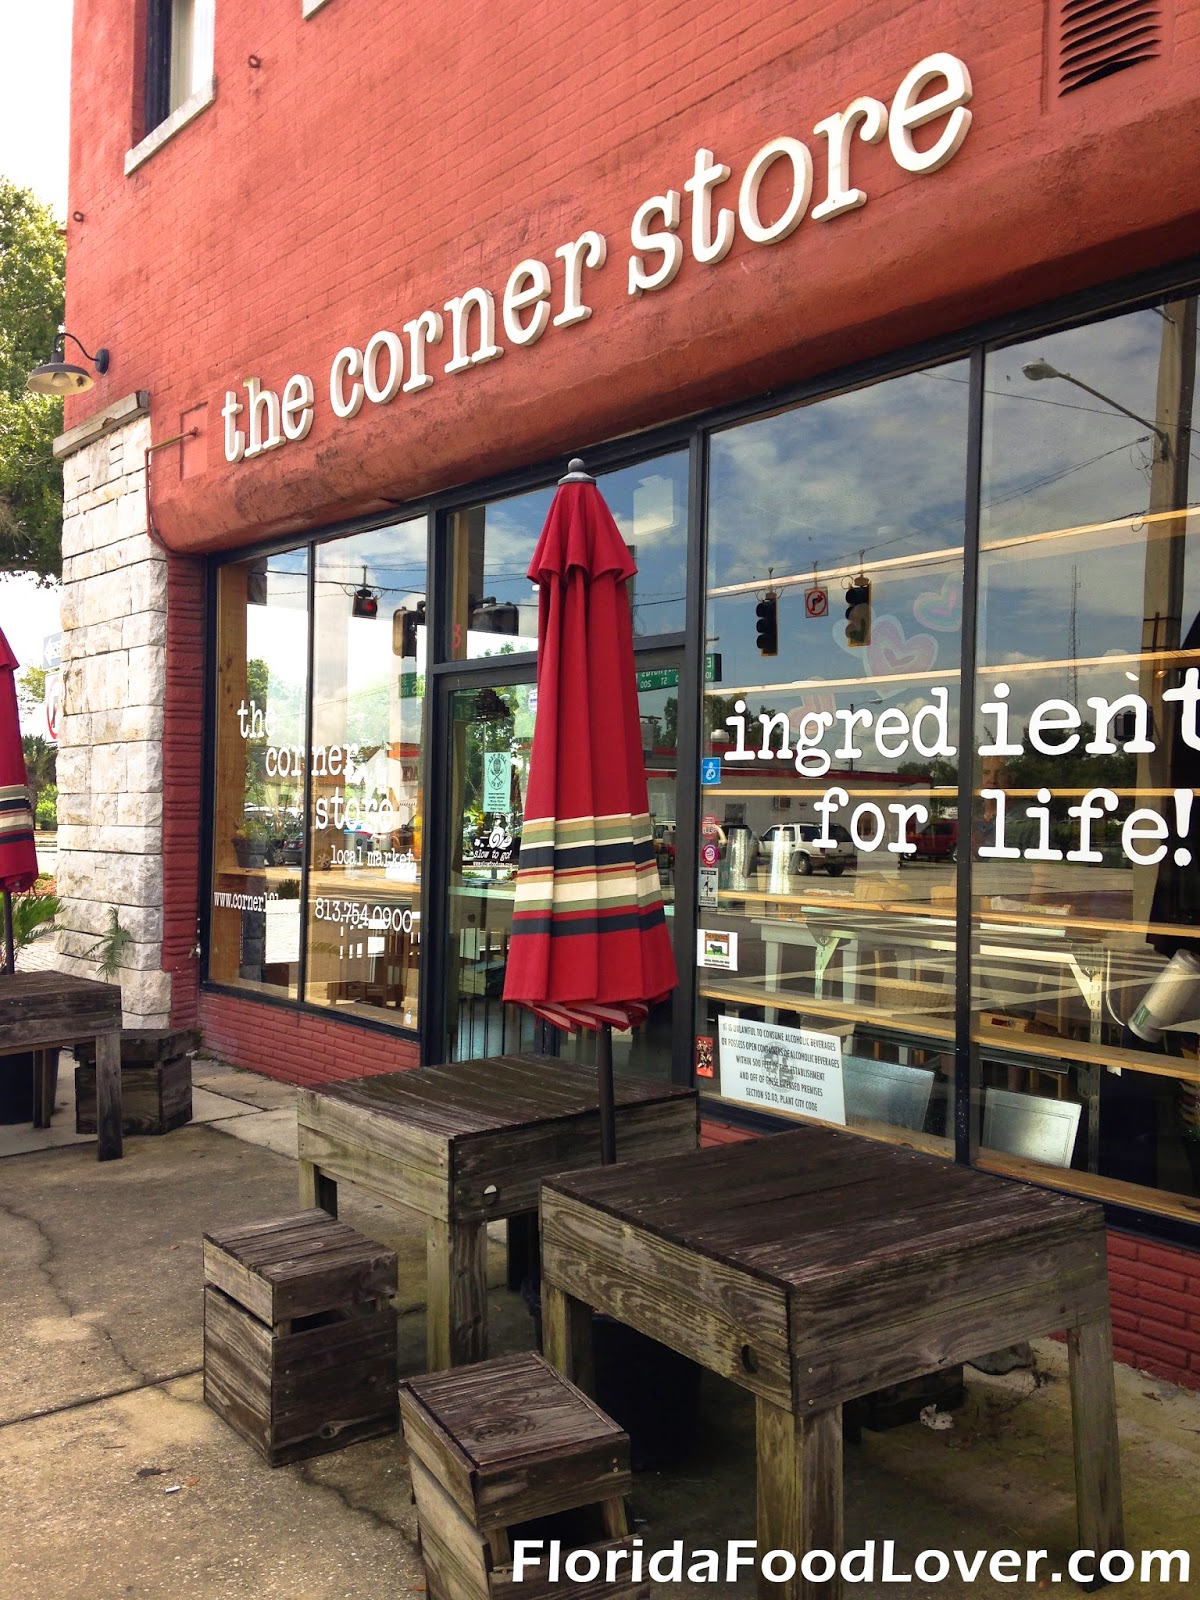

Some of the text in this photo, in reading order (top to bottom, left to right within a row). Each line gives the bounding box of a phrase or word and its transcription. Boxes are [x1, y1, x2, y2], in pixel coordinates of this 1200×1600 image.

[222, 52, 974, 463] the corner store
[315, 787, 394, 833] store
[812, 786, 1194, 867] for life!
[330, 845, 414, 869] local market
[757, 1028, 762, 1037] TO
[763, 1030, 784, 1041] CONSUME
[785, 1034, 809, 1046] ALCOHOLIC
[810, 1039, 836, 1051] BEVERAGES
[728, 1039, 745, 1049] POSSESS
[746, 1041, 757, 1051] OPEN
[790, 1051, 814, 1062] ALCOHOLIC
[815, 1055, 839, 1068] BEVERAGES
[736, 1055, 751, 1065] WITHIN
[752, 1058, 760, 1067] 500
[790, 1066, 825, 1081] ESTABLISHMENT
[740, 1071, 749, 1080] AND
[750, 1073, 758, 1082] OFF
[759, 1075, 765, 1083] OF
[801, 1083, 823, 1097] PREMISES
[746, 1087, 763, 1098] SECTION
[780, 1095, 794, 1106] PLANT
[795, 1098, 804, 1108] CITY
[805, 1101, 817, 1111] CODE
